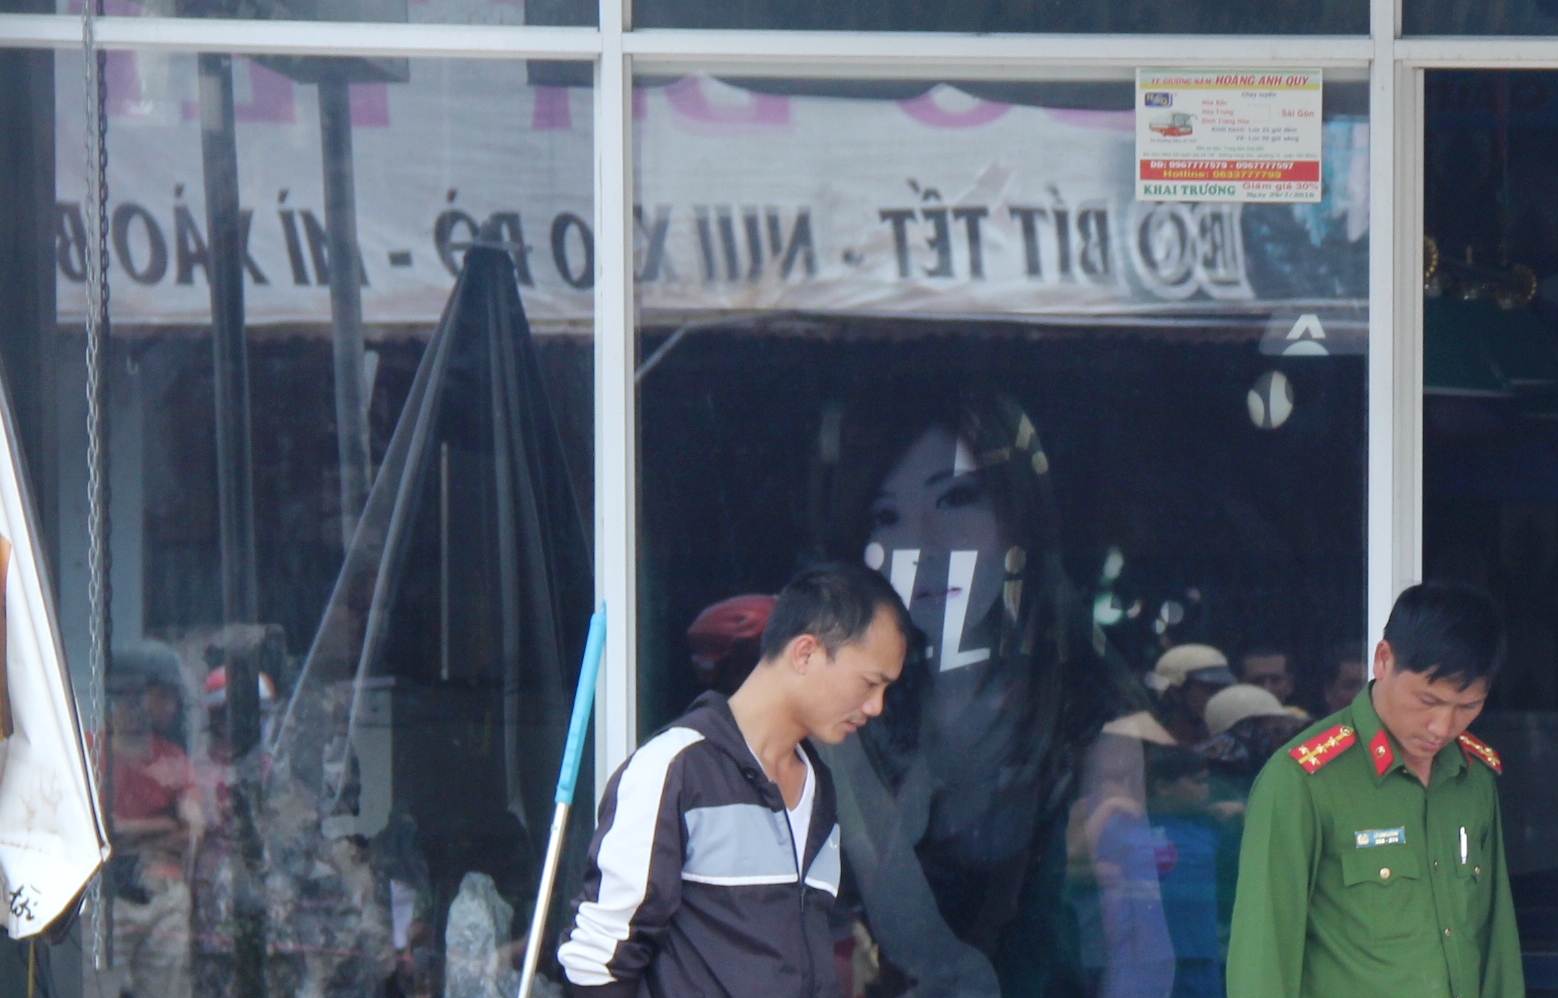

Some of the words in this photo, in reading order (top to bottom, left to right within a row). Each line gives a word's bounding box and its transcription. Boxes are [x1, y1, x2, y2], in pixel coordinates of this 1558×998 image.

[1258, 75, 1282, 86] ANH
[1143, 184, 1177, 195] KHAI
[1181, 182, 1236, 196] TRƯƠNG
